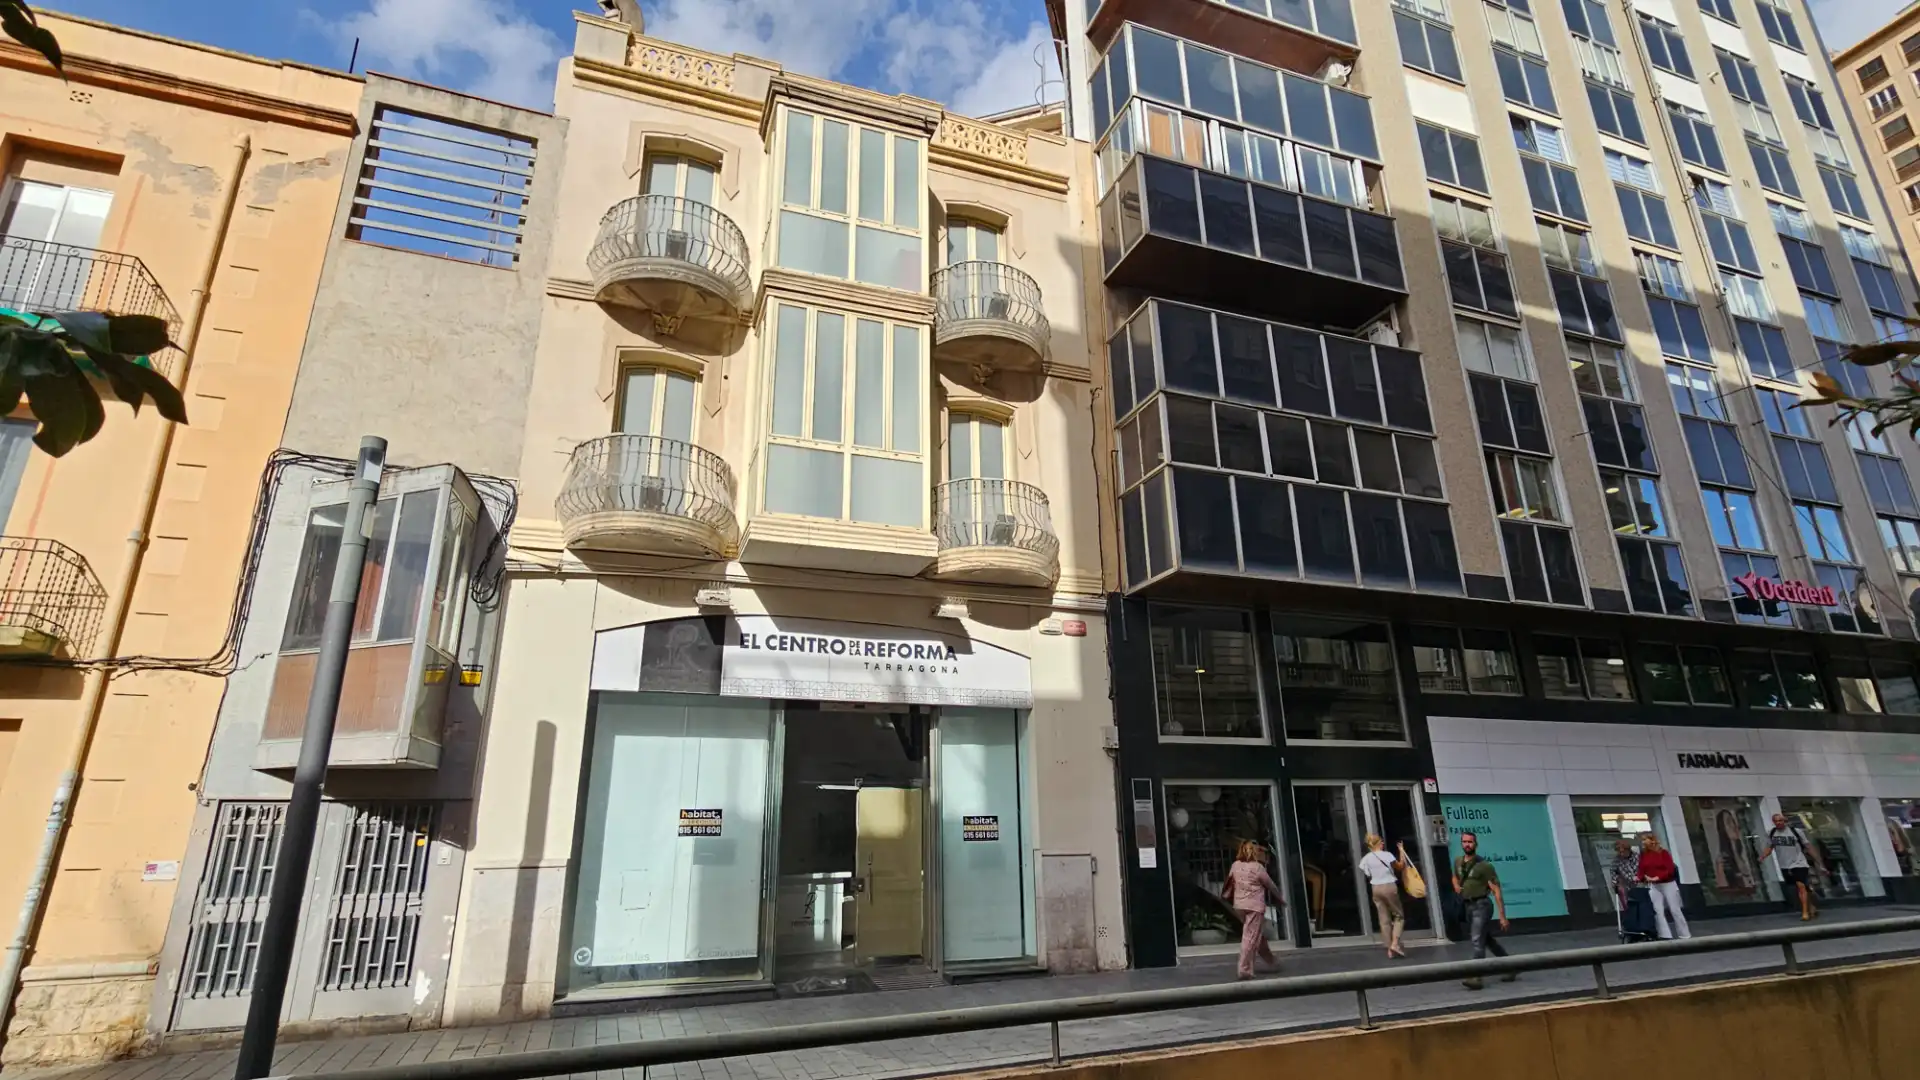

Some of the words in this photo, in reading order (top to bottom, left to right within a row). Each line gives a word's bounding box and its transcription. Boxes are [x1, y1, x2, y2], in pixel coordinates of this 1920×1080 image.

[1757, 577, 1837, 606] Occident
[740, 633, 760, 649] EL
[765, 634, 846, 655] CENTRO
[849, 640, 860, 648] DE
[864, 641, 958, 661] REFORMA
[849, 648, 861, 656] LA
[864, 662, 958, 674] TARRAGONA
[681, 810, 715, 818] habitat
[1446, 806, 1489, 820] Fullana
[965, 817, 993, 825] habitat
